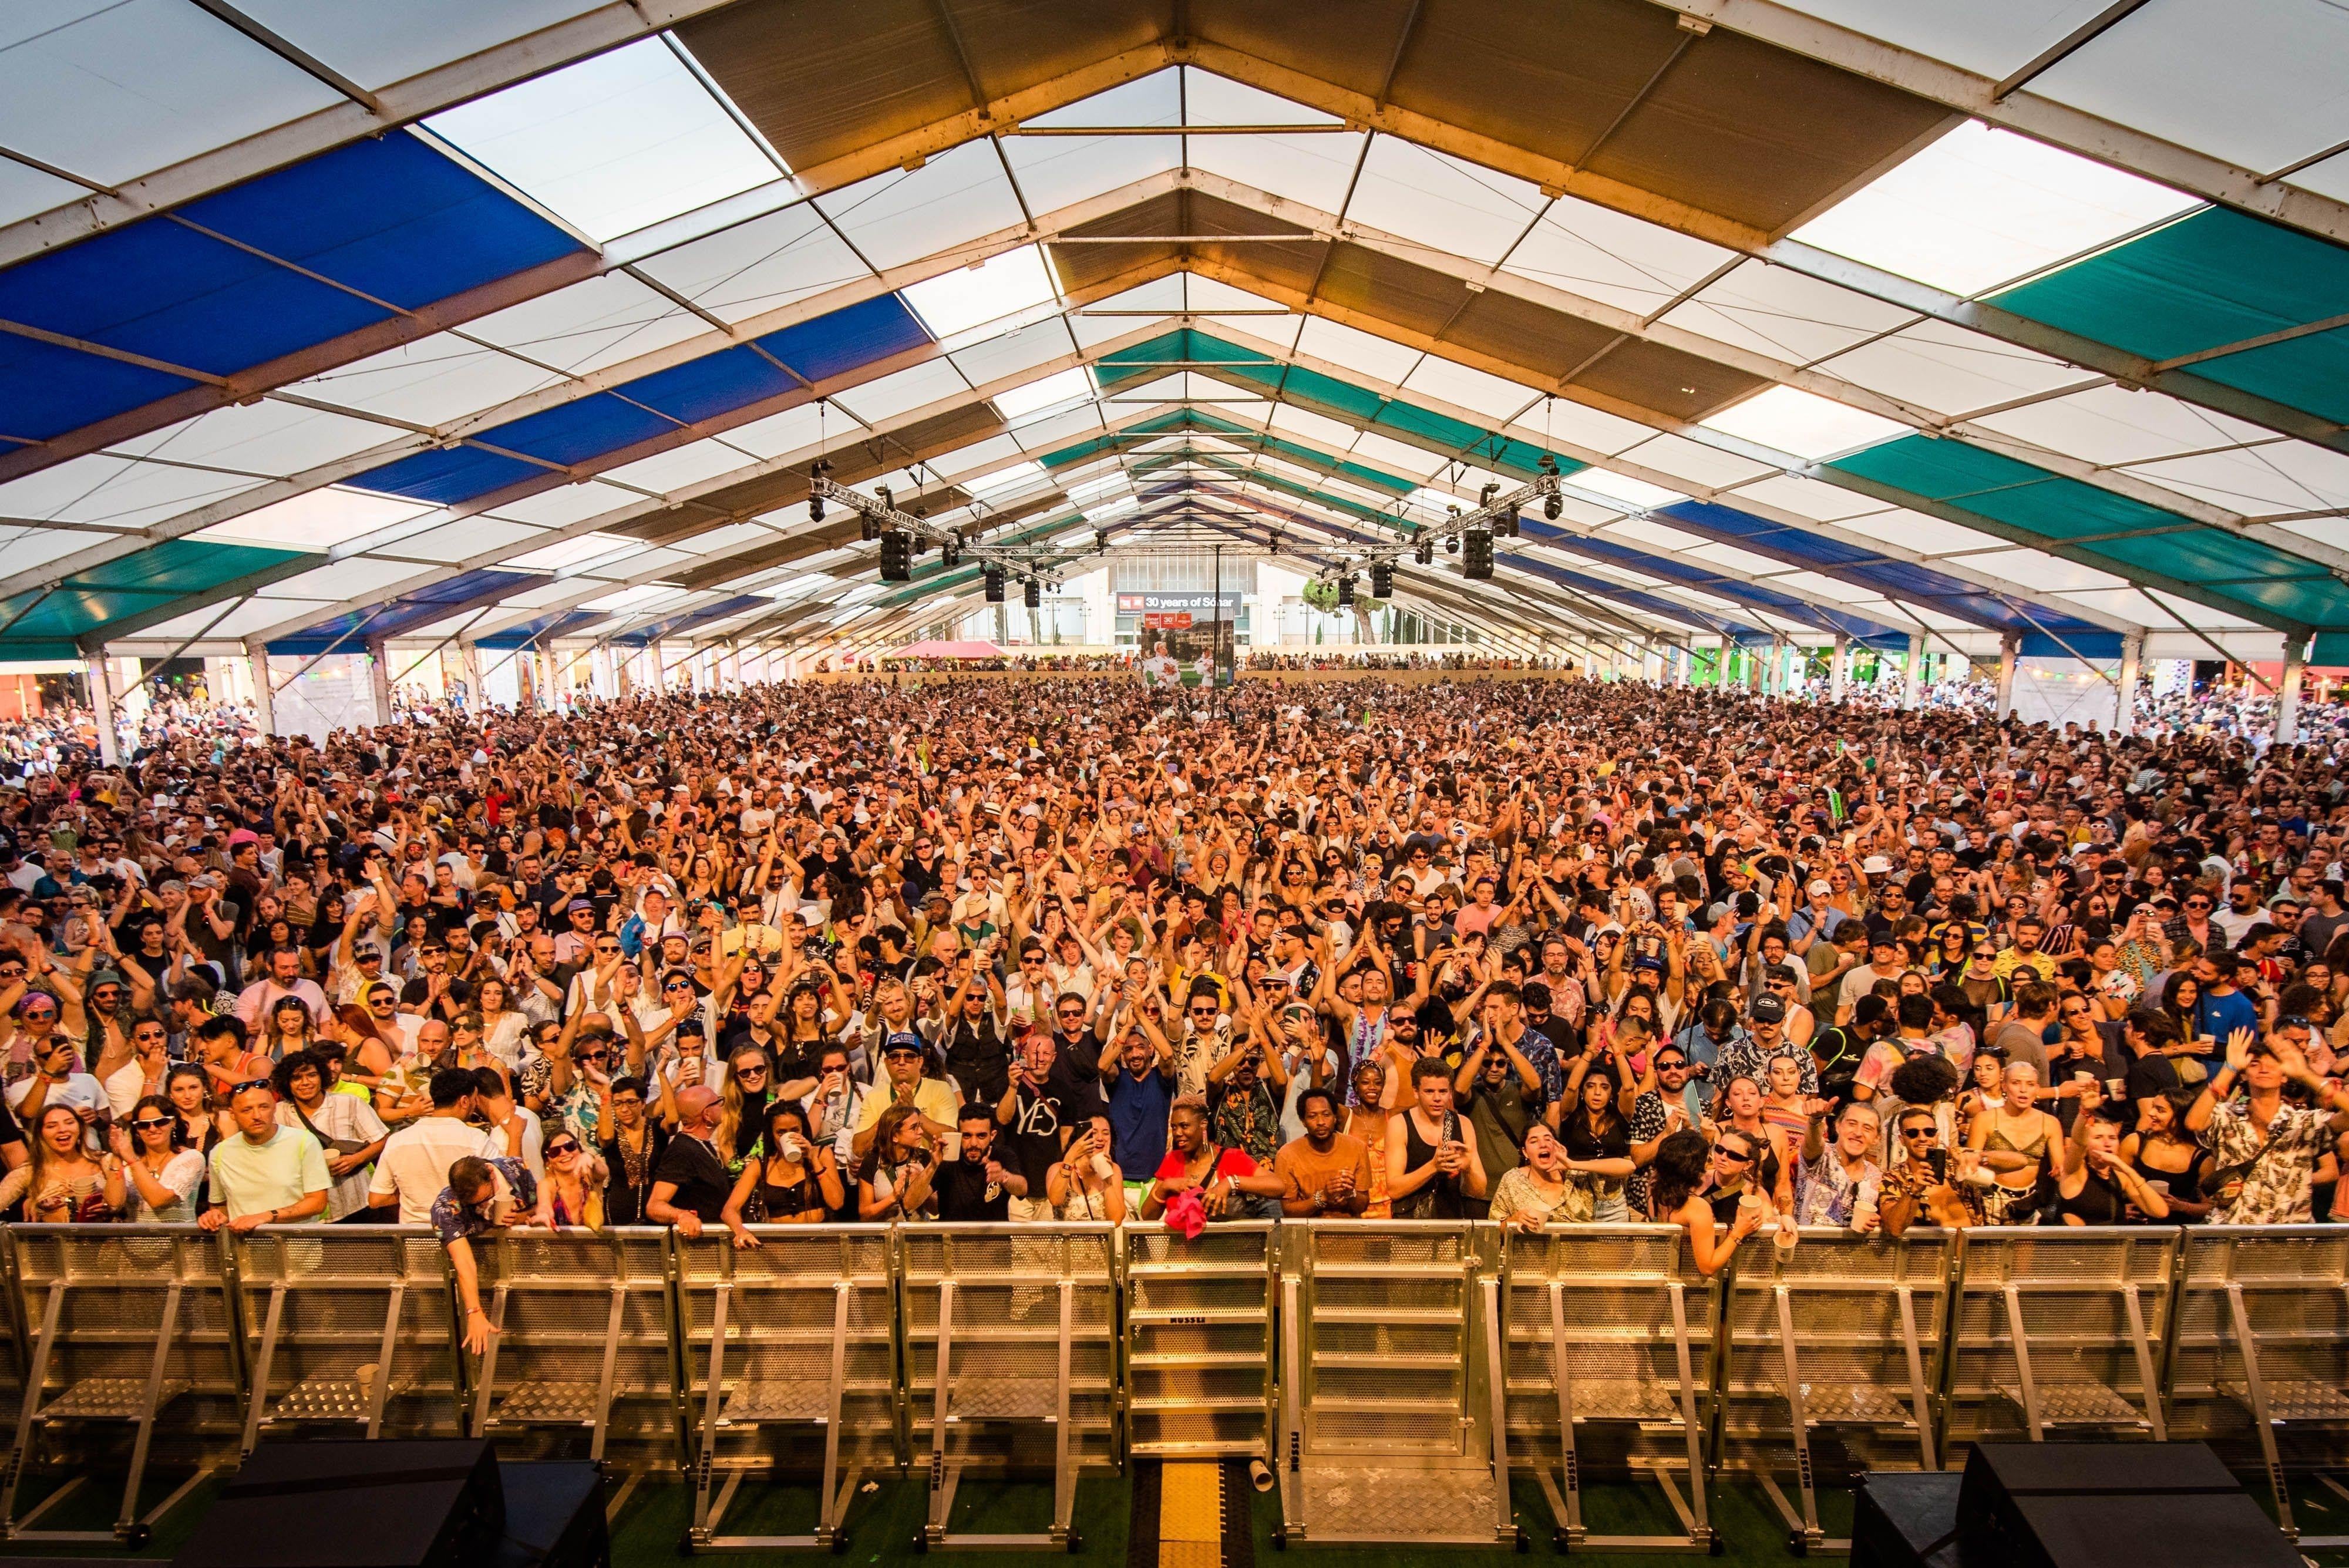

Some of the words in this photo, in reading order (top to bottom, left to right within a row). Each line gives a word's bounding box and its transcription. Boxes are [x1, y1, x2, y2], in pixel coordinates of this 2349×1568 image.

[1146, 597, 1159, 607] 30
[1160, 598, 1188, 608] years
[1190, 597, 1201, 607] of
[900, 1034, 915, 1042] LOST
[1016, 1094, 1061, 1136] YES
